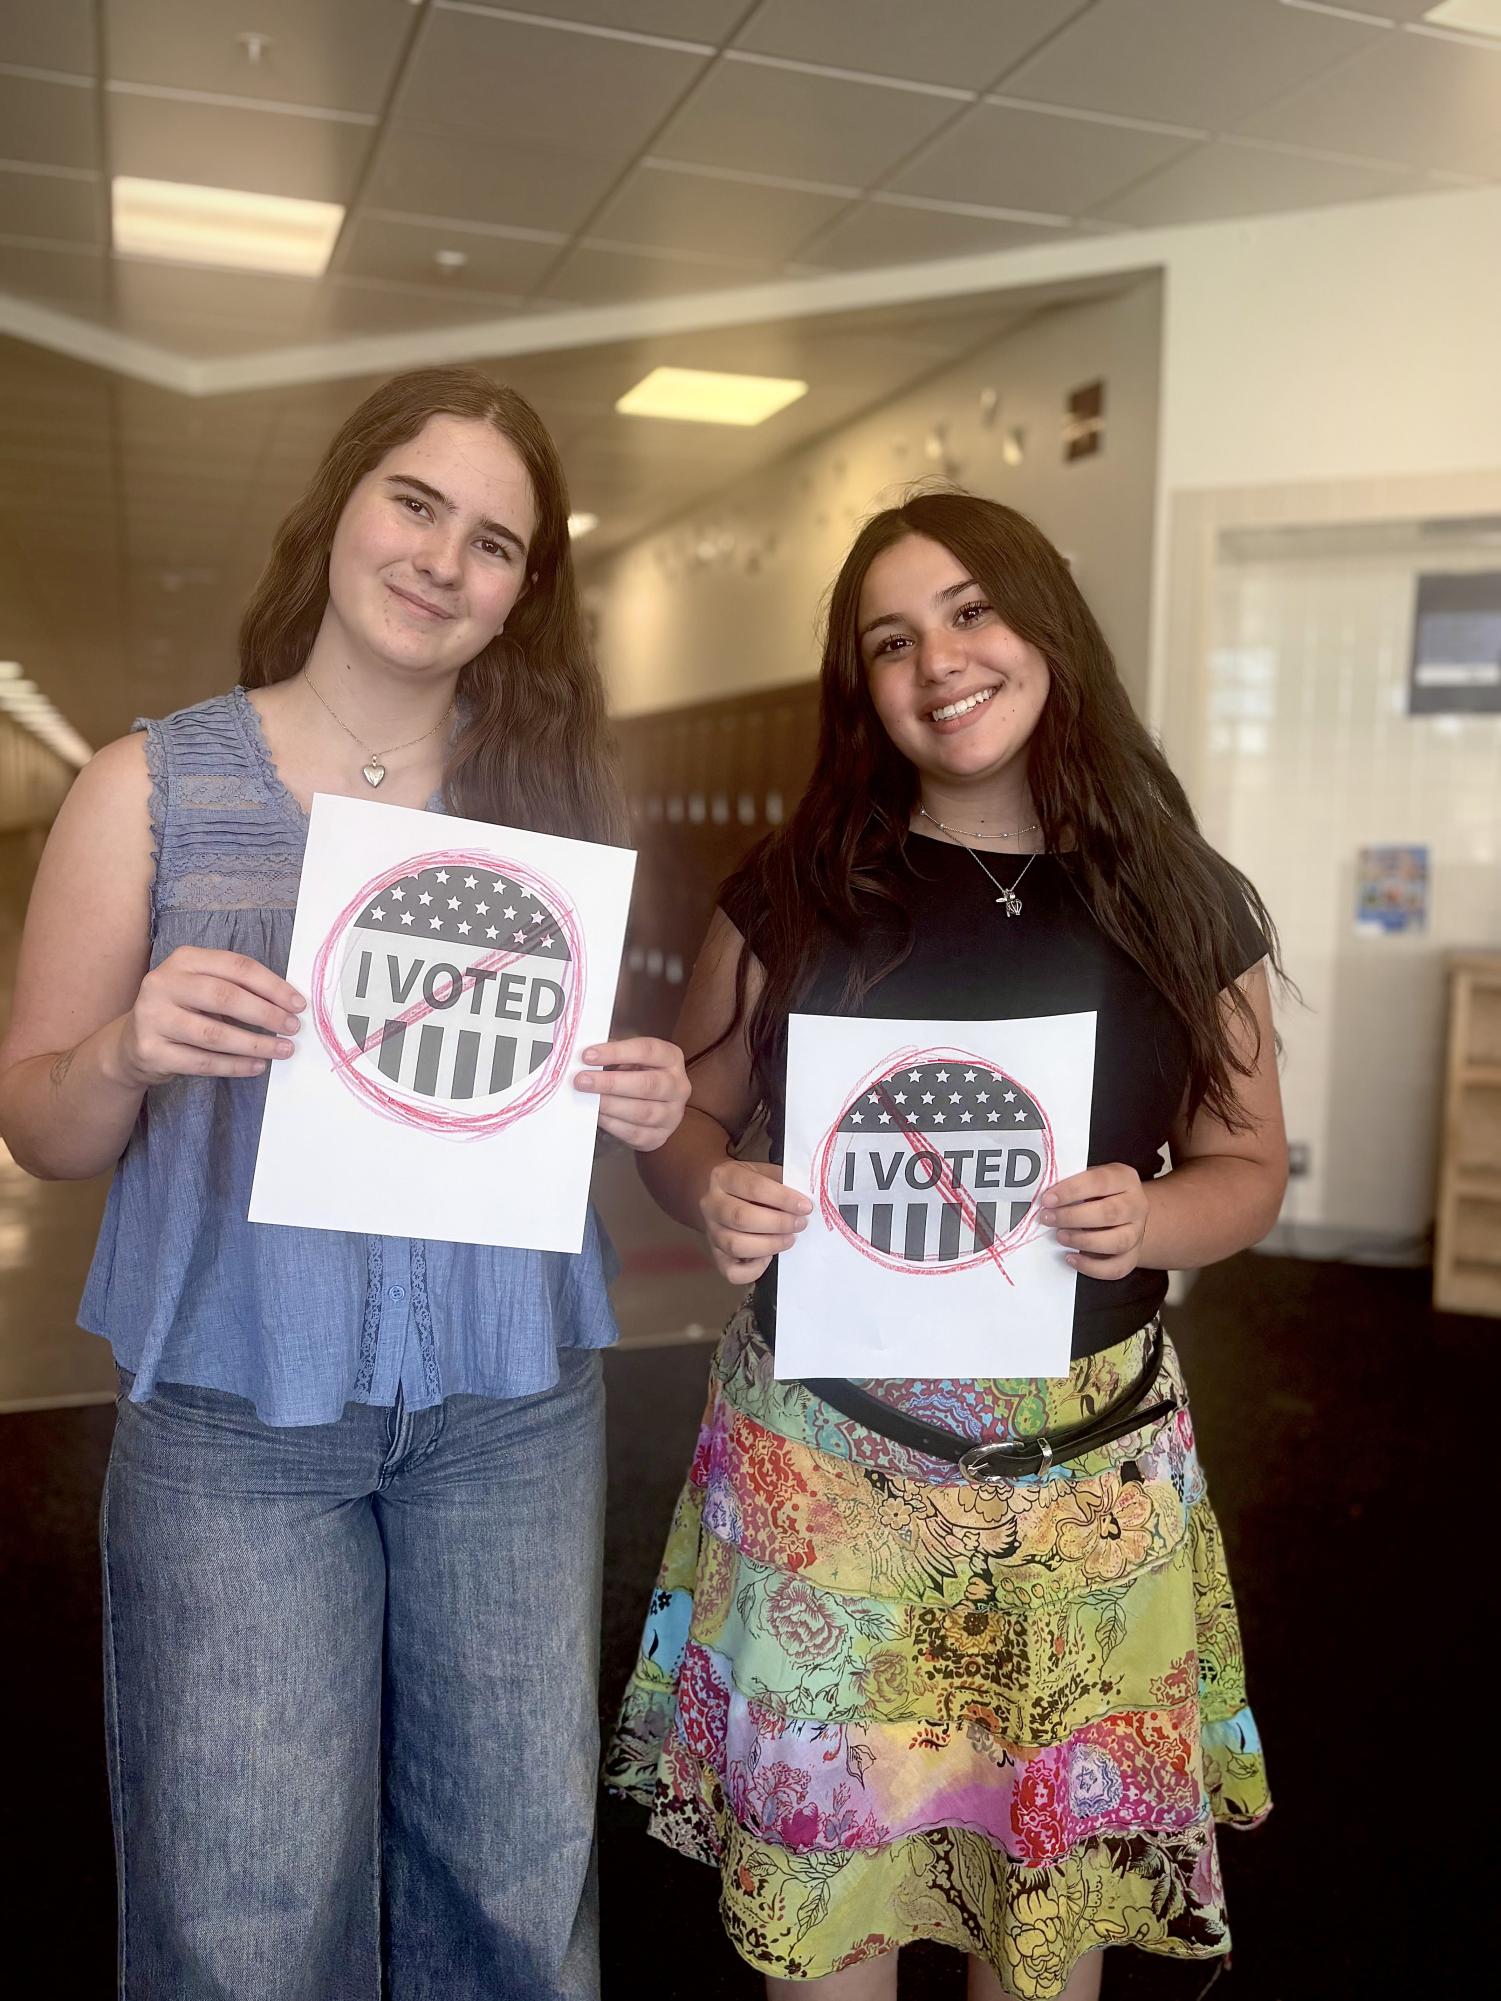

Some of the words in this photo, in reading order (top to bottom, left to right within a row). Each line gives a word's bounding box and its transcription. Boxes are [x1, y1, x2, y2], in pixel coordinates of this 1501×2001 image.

[355, 951, 372, 998] I
[386, 954, 565, 1024] VOTED
[843, 1151, 856, 1191] I
[868, 1148, 1042, 1191] VOTED
